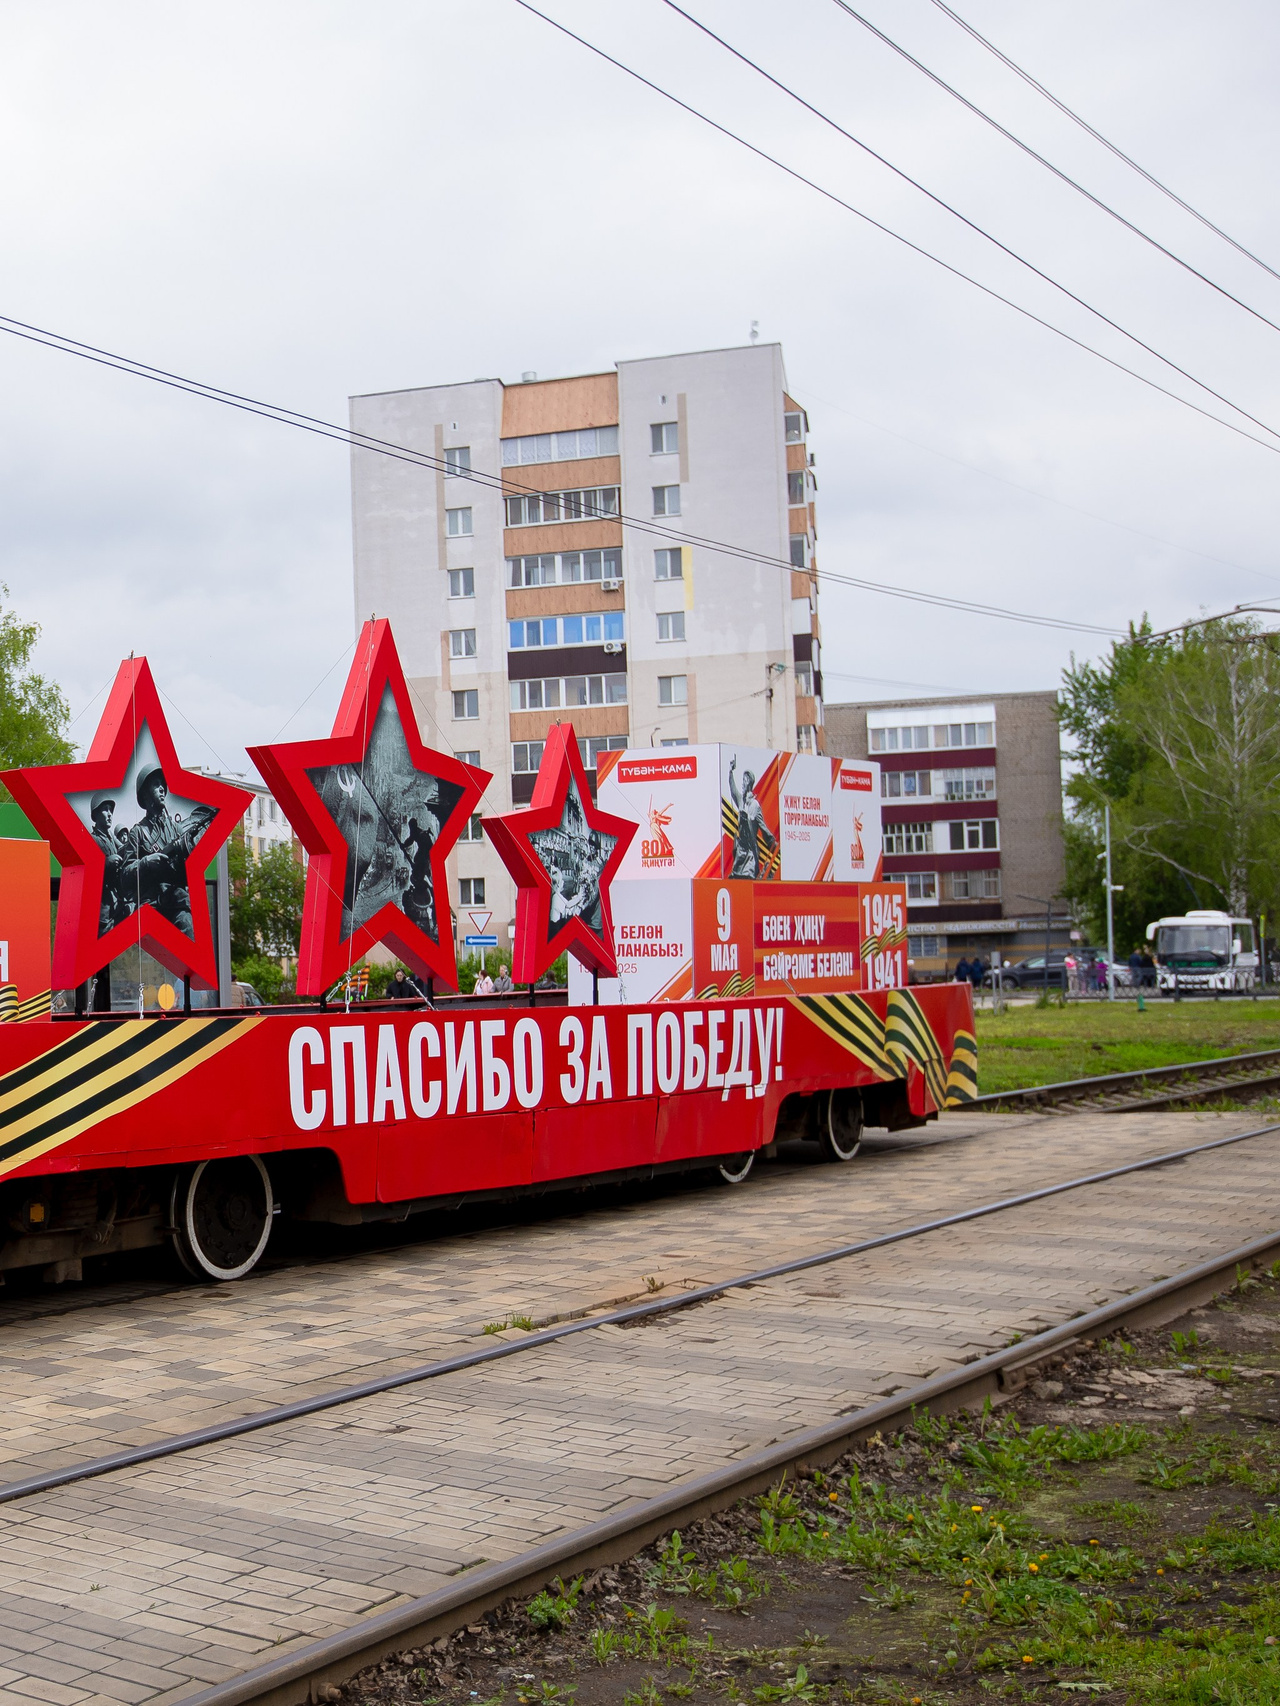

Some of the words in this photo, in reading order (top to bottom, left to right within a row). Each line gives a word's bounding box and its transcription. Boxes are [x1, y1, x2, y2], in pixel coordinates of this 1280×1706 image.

[641, 839, 661, 857] 80
[716, 887, 731, 942] 9
[762, 915, 791, 942] БӨЕК
[862, 893, 903, 937] 1945
[620, 925, 664, 940] БЕЛӘН
[615, 943, 684, 958] ЛАНАБЫЗ!
[710, 943, 739, 972] МАЯ
[817, 951, 854, 978] БЕЛӘН!
[864, 950, 903, 991] 1941
[288, 1016, 545, 1131] СПАСИБО
[558, 1014, 613, 1105] ЗА
[626, 1006, 785, 1102] ПОБЕДУ!
